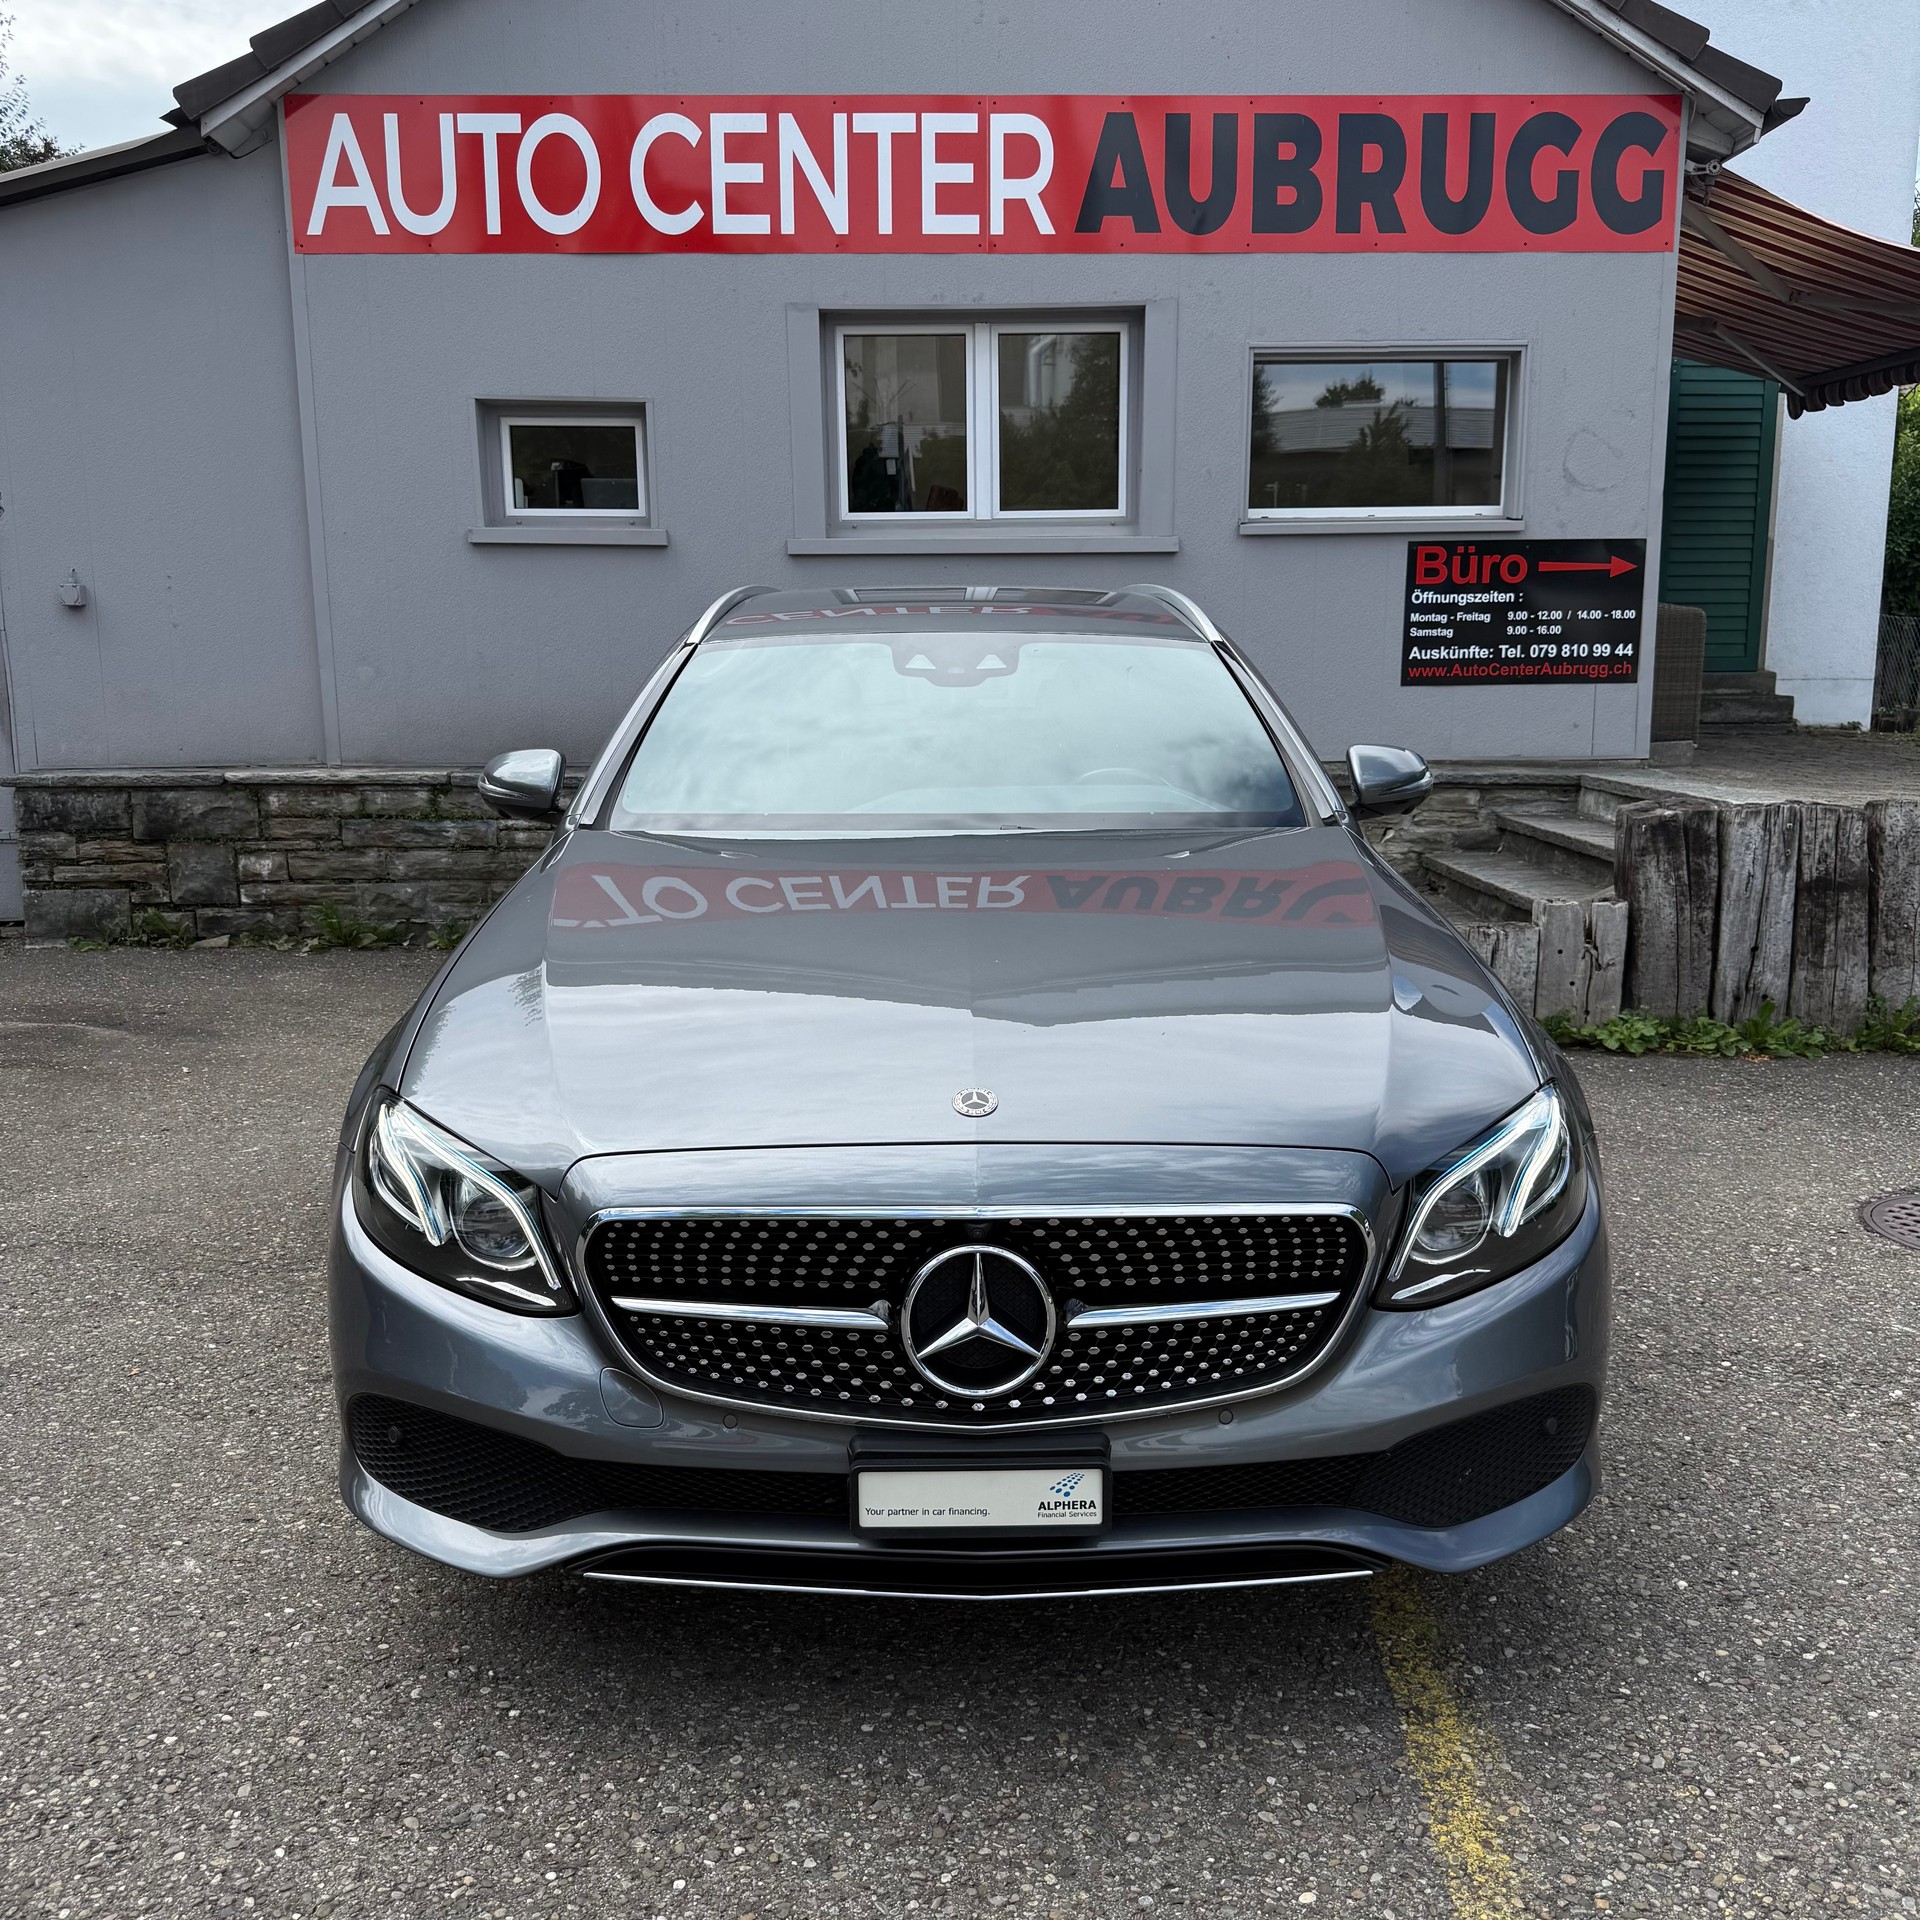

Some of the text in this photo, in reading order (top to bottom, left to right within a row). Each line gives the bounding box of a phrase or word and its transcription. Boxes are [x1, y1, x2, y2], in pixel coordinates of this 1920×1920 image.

[306, 111, 1669, 236] AUTO CENTER AUBRUGG
[1415, 545, 1529, 585] Büro
[1411, 589, 1515, 606] Öffnungszeiten
[1410, 613, 1448, 624] Montag
[1456, 611, 1491, 623] Freitag
[1507, 611, 1528, 620] 9.00
[1537, 610, 1563, 620] 12.00
[1577, 610, 1602, 619] 14.00
[1611, 609, 1636, 619] 18.00
[1409, 627, 1454, 638] Samstag
[1506, 625, 1527, 635] 9.00
[1536, 625, 1562, 634] 16.00
[1408, 643, 1633, 660] Auskünfte: Tel. 079 810 99 44
[1408, 661, 1632, 678] www.AutoCenterAubrugg.ch
[865, 1507, 991, 1517] Your partner in car financing.
[1038, 1500, 1097, 1511] ALPHERA
